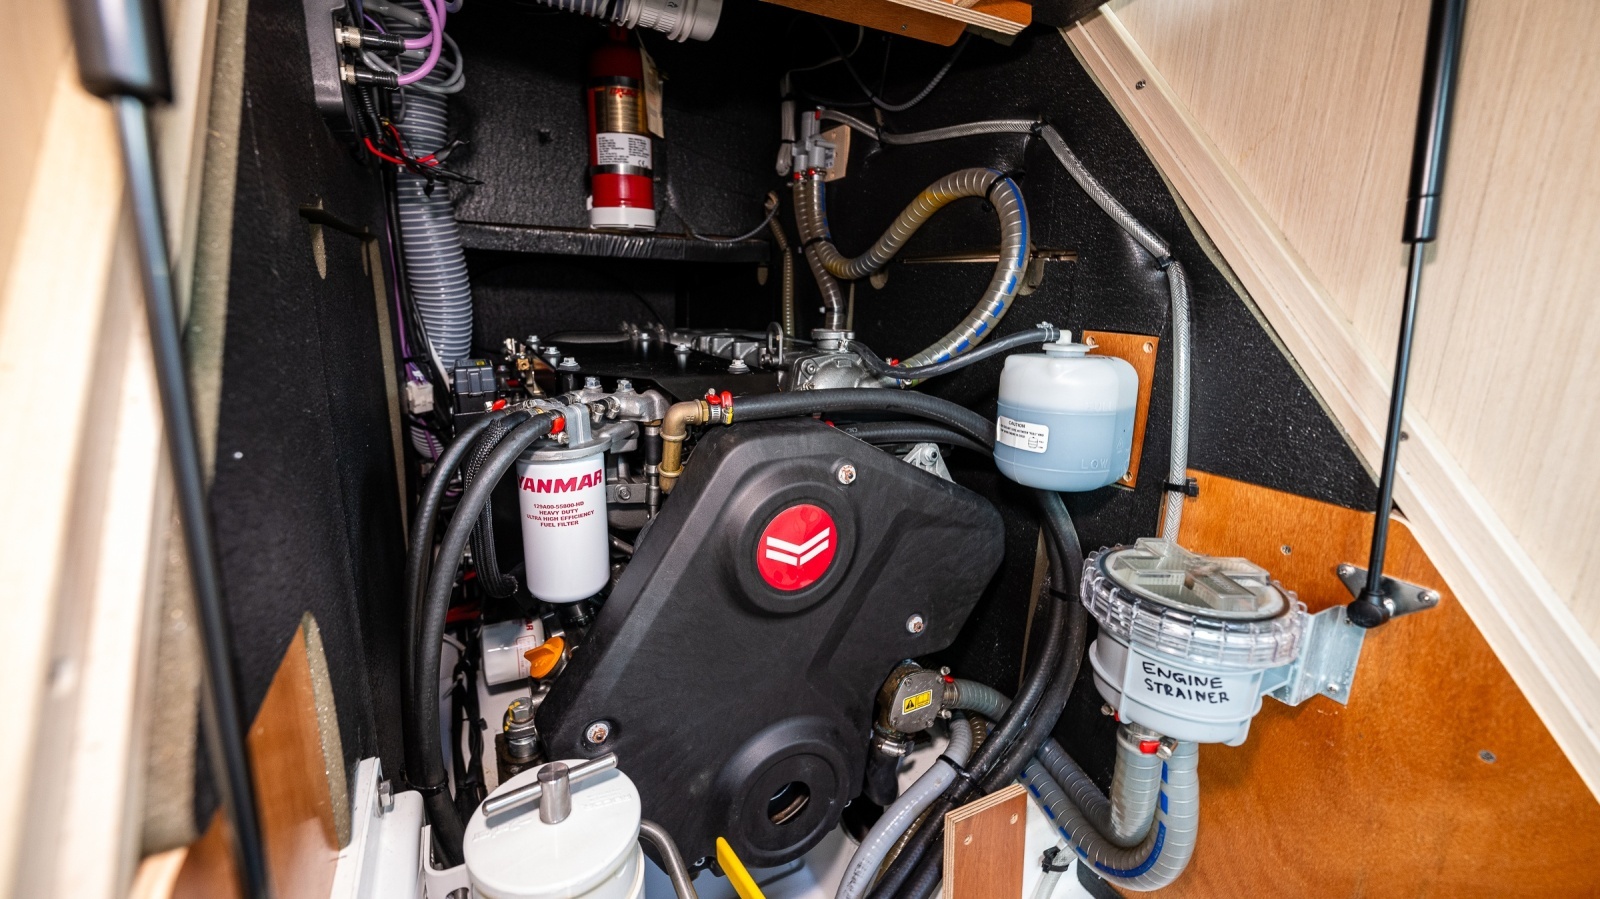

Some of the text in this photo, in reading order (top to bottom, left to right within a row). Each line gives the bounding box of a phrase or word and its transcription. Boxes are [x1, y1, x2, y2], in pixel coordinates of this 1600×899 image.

[1009, 420, 1026, 429] CAUTION
[1081, 458, 1109, 469] LOW
[517, 469, 602, 493] YANMAR
[526, 513, 542, 521] ULTRA
[560, 510, 595, 521] EFFICIENCY
[1142, 661, 1223, 689] ENGINE
[1144, 677, 1230, 704] STRAINER
